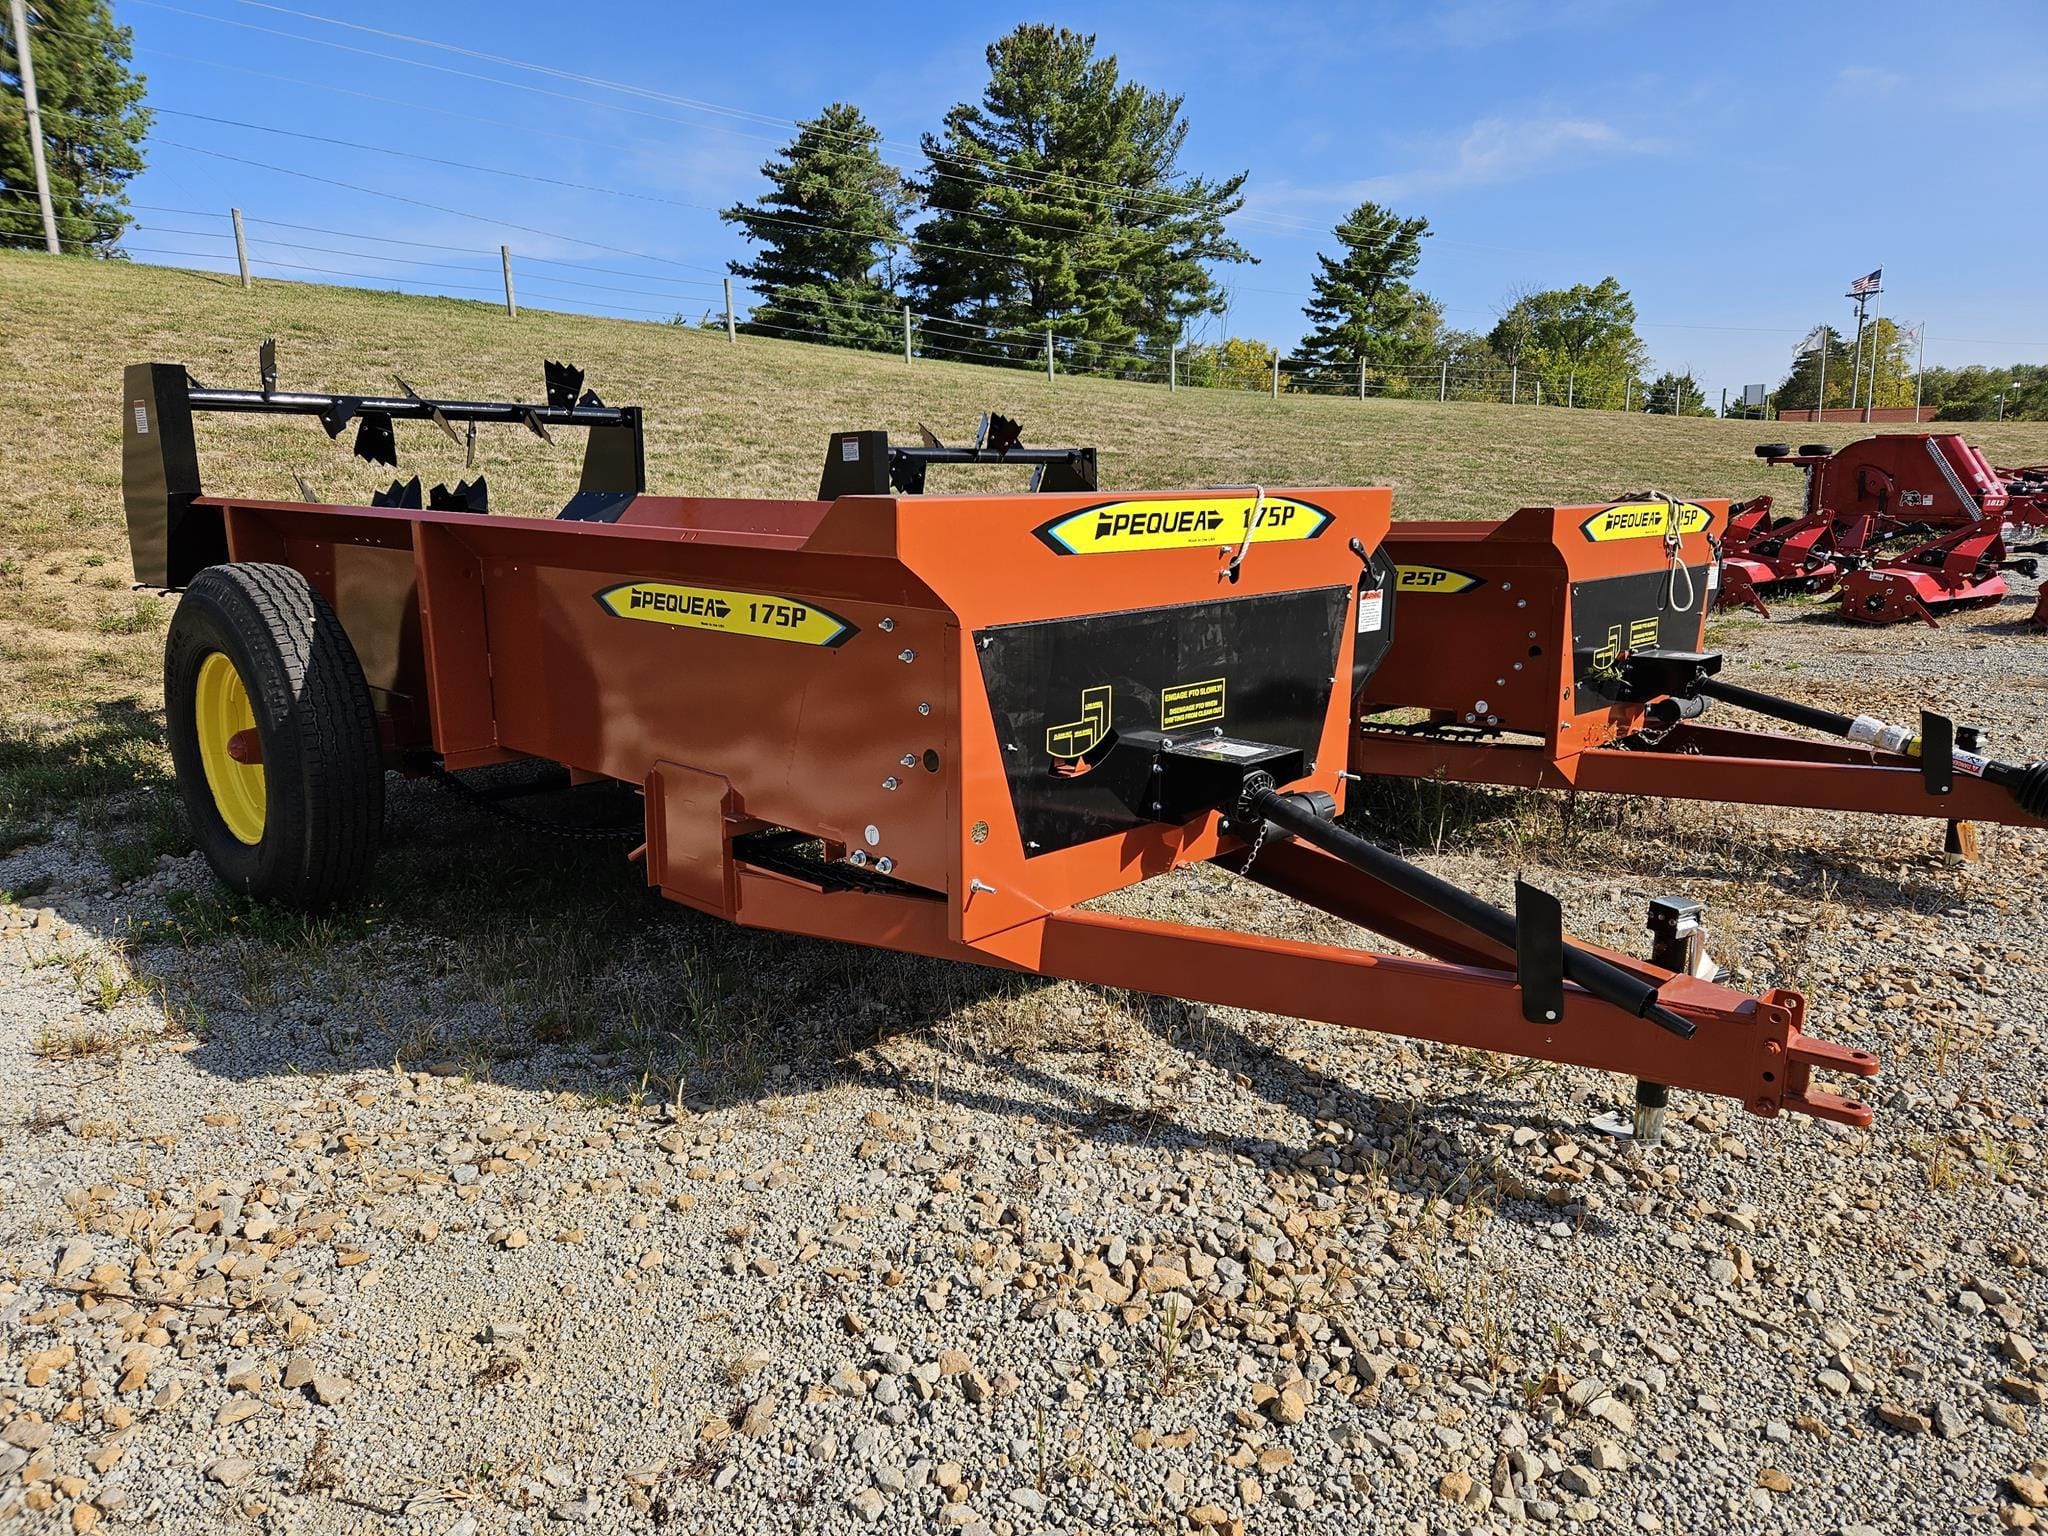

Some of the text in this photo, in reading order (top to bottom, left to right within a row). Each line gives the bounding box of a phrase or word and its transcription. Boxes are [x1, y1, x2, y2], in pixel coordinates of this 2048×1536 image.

[1986, 499, 2006, 507] 1812
[1112, 506, 1295, 536] PEQUEA 175P
[1613, 512, 1654, 529] PEQUEA
[1396, 571, 1446, 586] 25P
[642, 591, 807, 628] PEQUEA 175P
[1165, 691, 1188, 702] ENGAGE
[1188, 688, 1200, 698] PTO
[1195, 702, 1205, 710] PTO
